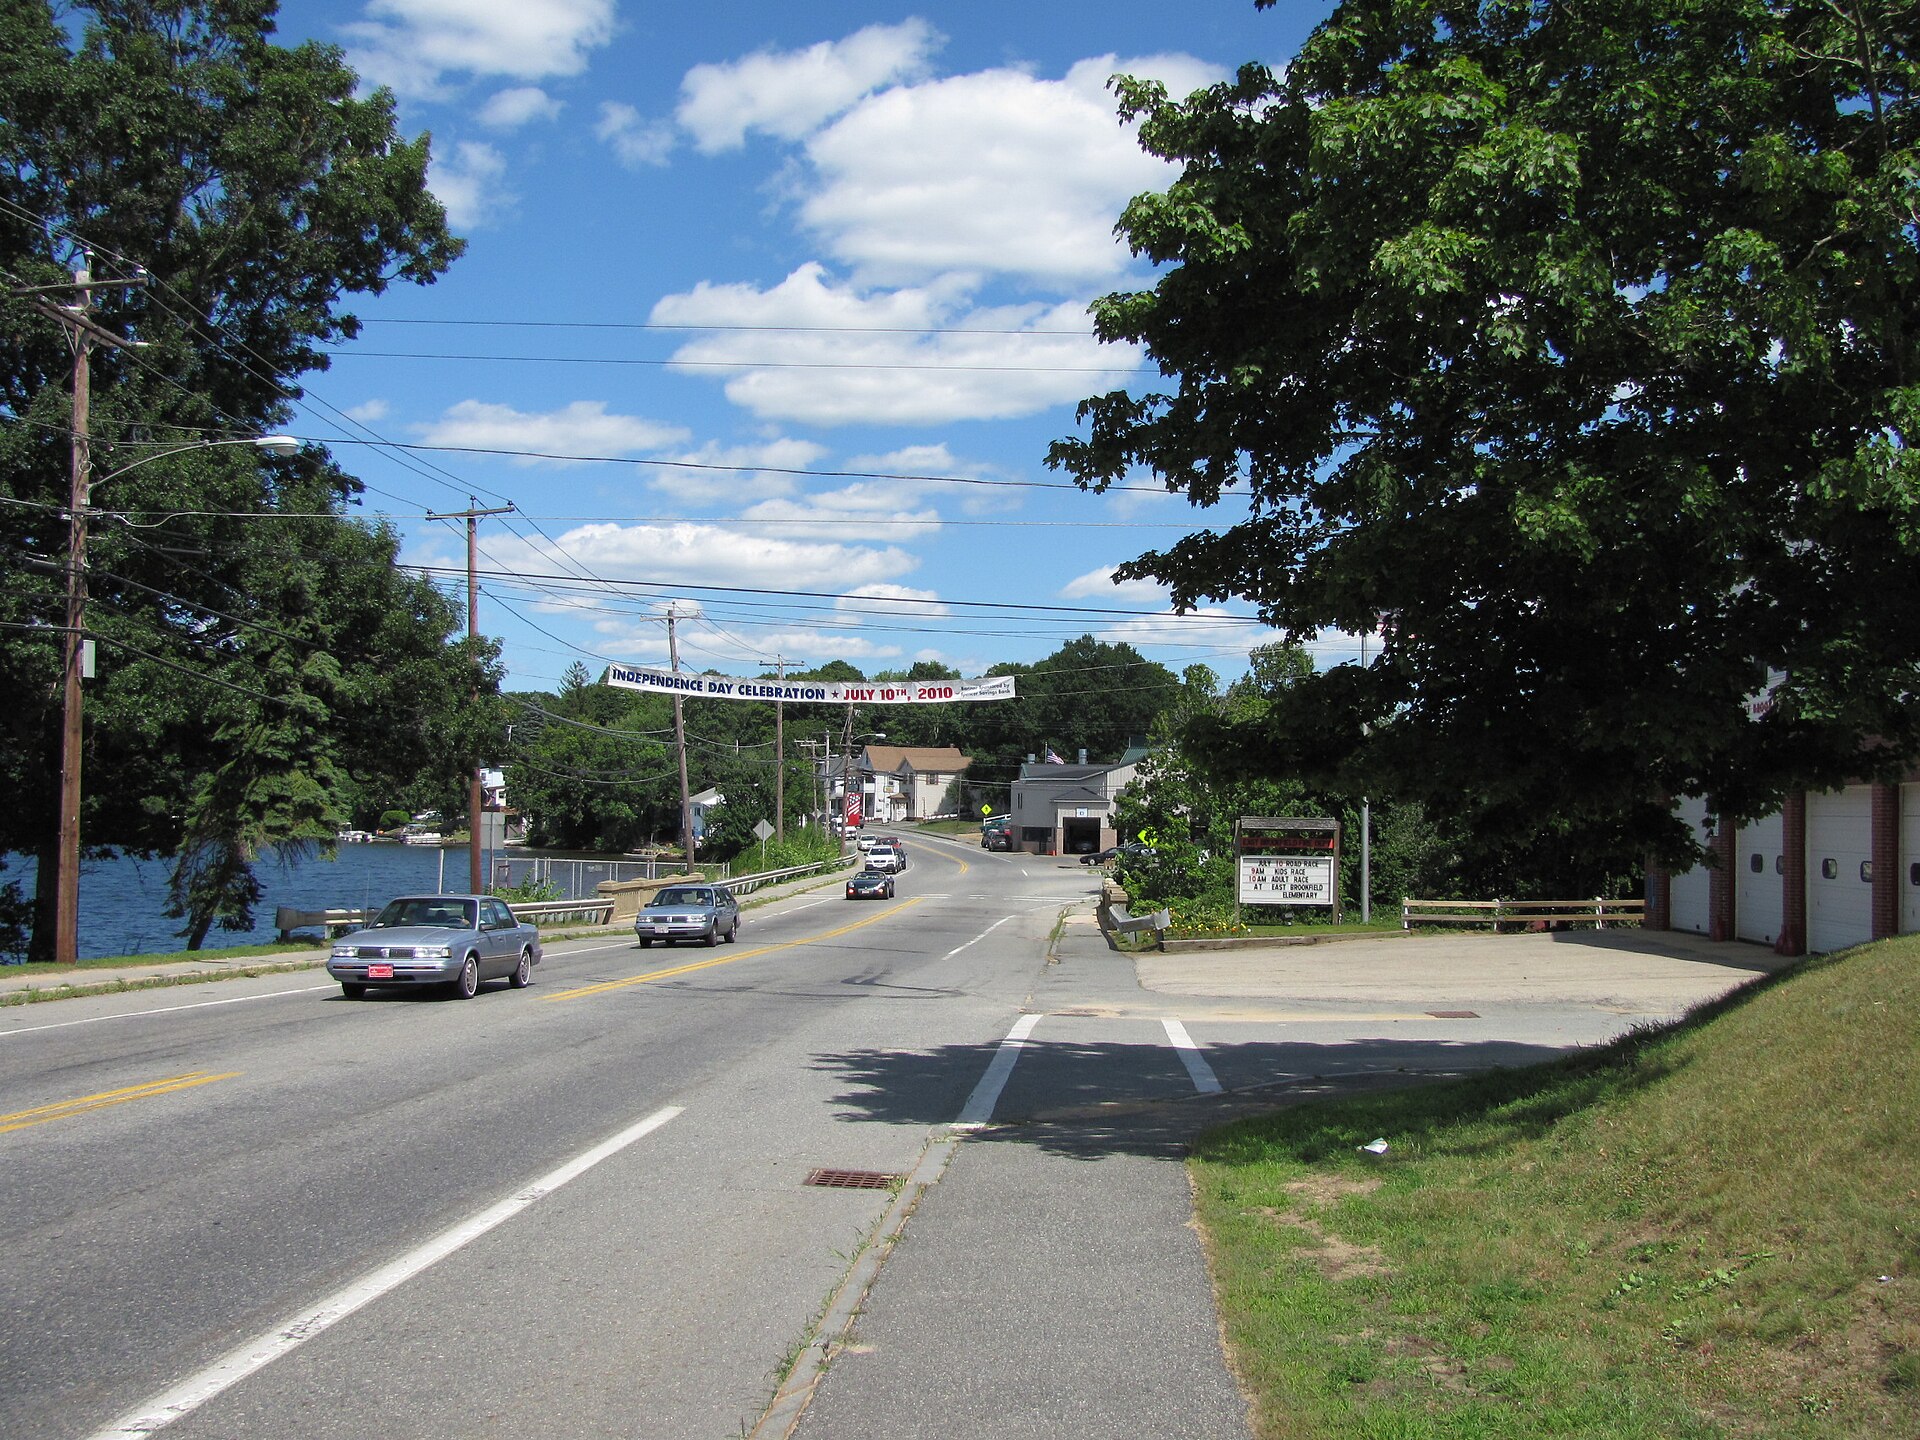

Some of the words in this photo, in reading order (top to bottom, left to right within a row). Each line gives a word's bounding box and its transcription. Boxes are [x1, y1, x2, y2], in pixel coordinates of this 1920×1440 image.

[612, 670, 703, 691] INDEPENDENCE
[708, 682, 734, 694] DAY
[738, 685, 825, 699] CELEBRATION
[843, 689, 876, 701] JULY
[918, 687, 953, 699] 2010
